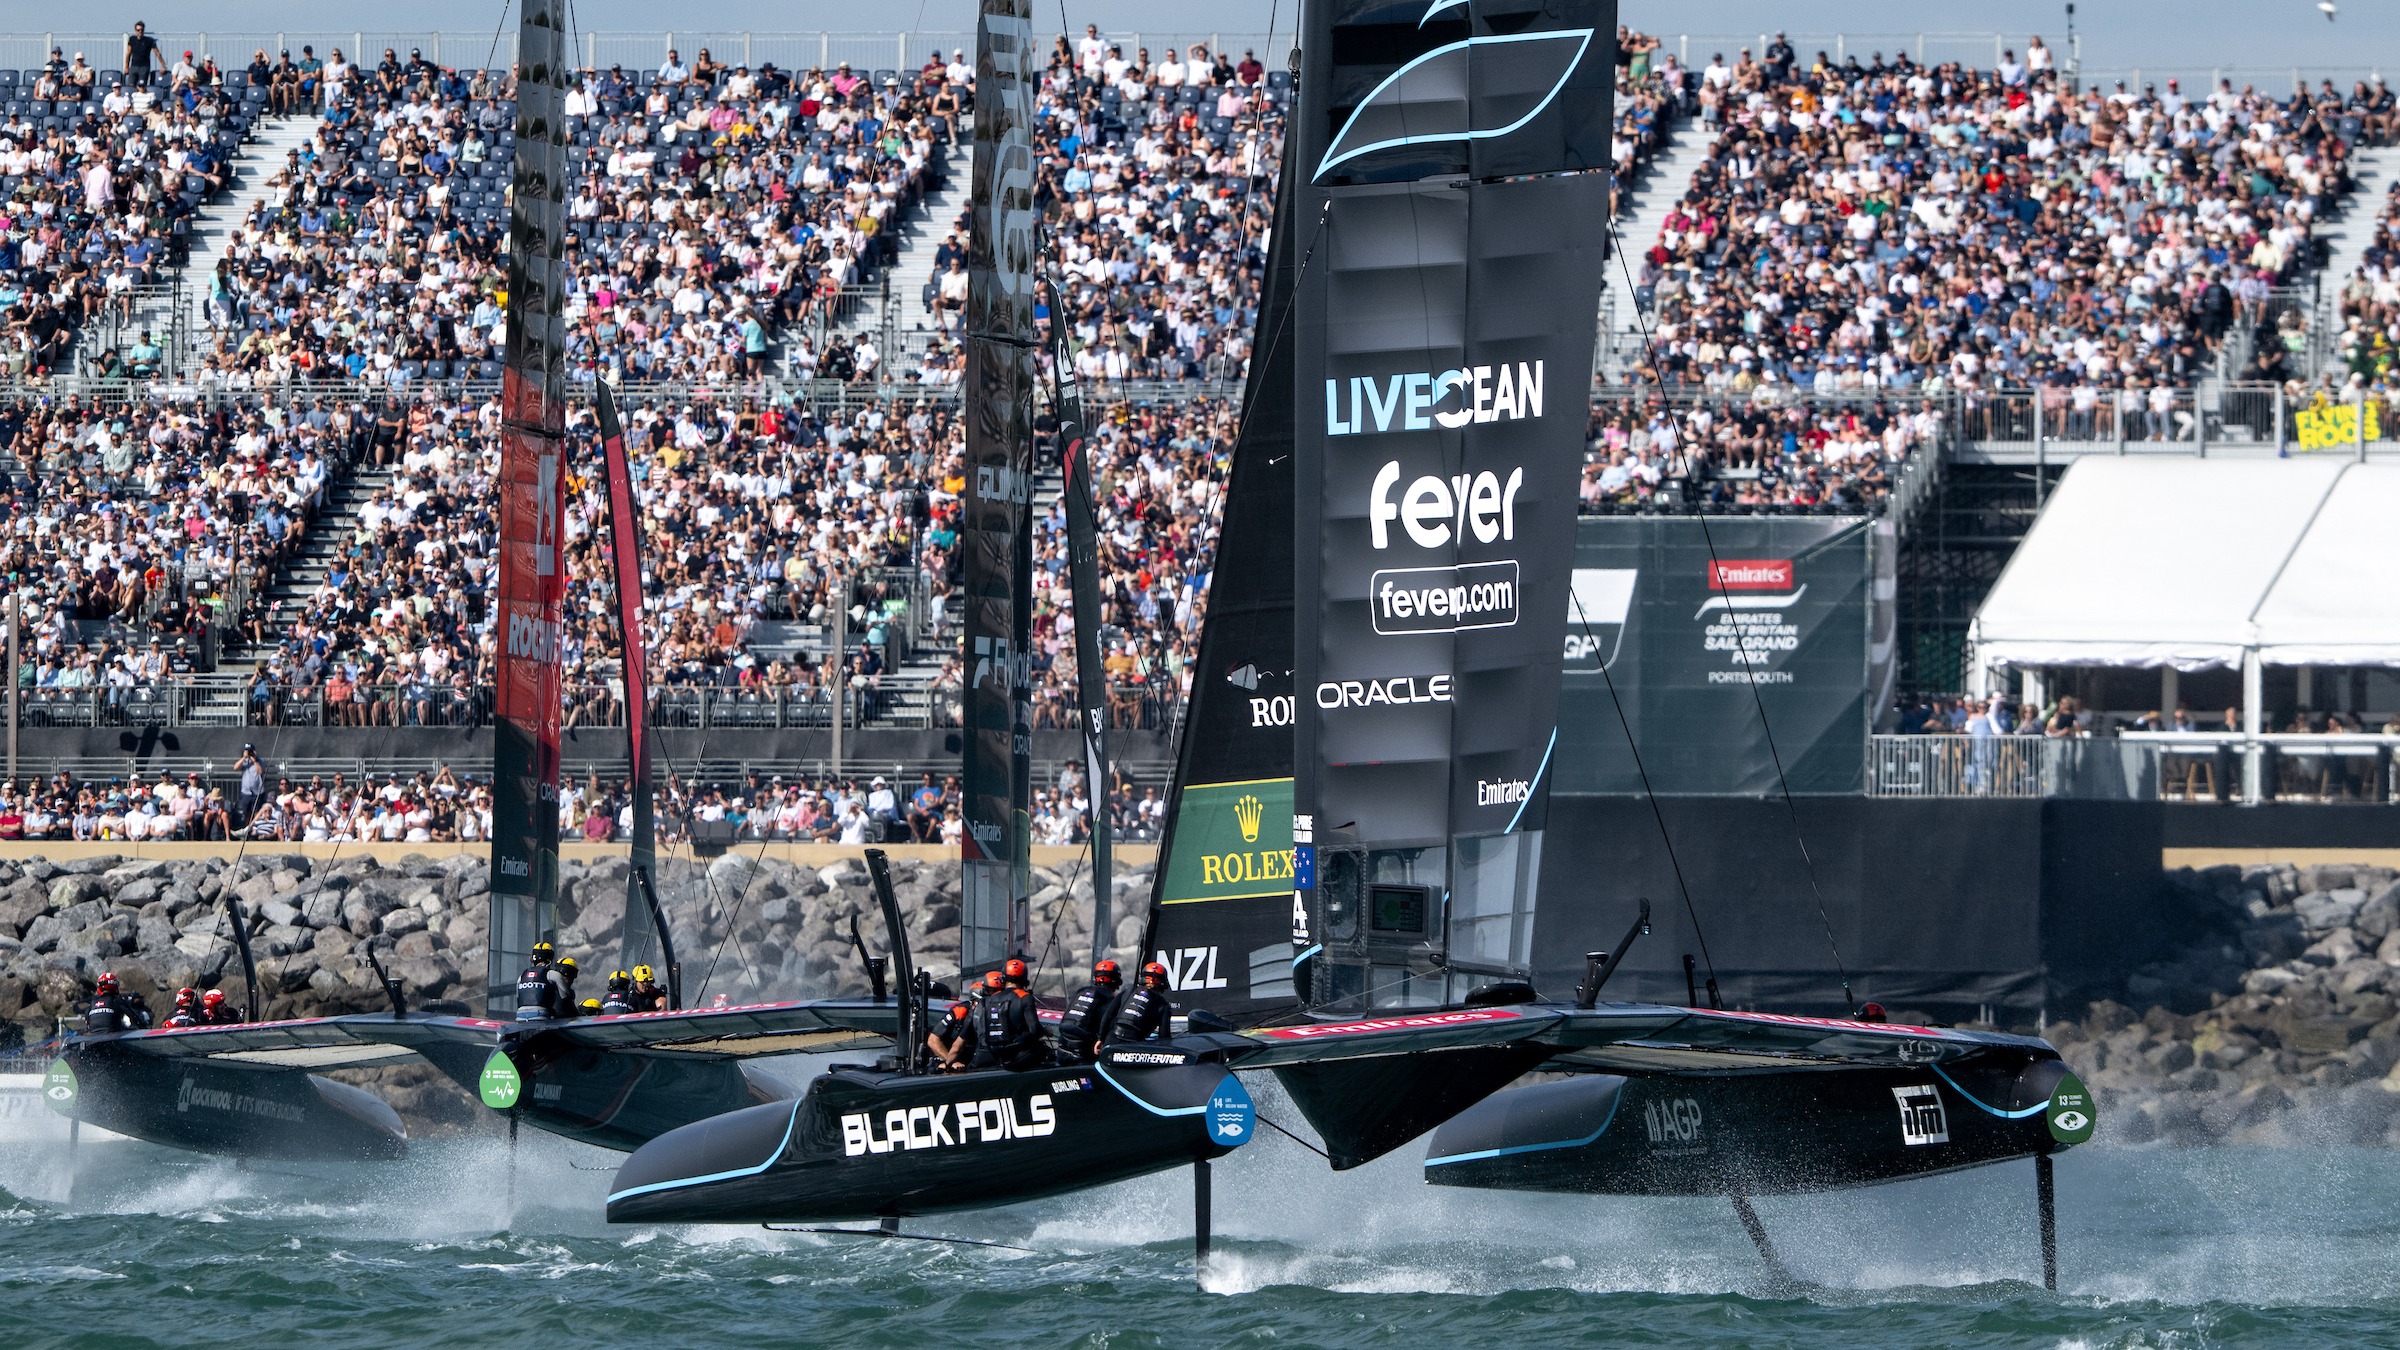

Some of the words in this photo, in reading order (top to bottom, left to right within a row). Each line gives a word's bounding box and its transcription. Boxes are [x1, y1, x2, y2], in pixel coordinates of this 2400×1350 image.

[1717, 566, 1786, 583] Emirates
[1720, 613, 1783, 625] EMIRATES
[1705, 625, 1746, 636] GREAT
[1747, 625, 1798, 636] BRITAIN
[1704, 636, 1740, 650] SAIL
[1741, 636, 1799, 650] GRAND
[1732, 650, 1770, 664] PRIX
[1708, 672, 1793, 684] PORTSMOUTH
[1316, 674, 1455, 709] ORACLE
[1478, 777, 1529, 806] Emirates
[973, 820, 1002, 842] Emirates
[501, 856, 529, 877] Emirates
[1201, 849, 1295, 884] ROLEX
[1156, 946, 1228, 991] NZL
[519, 982, 546, 990] SCOTT
[1288, 1009, 1493, 1036] Emirates
[1113, 1052, 1186, 1065] #RACEFORTHEFUTURE
[485, 1070, 491, 1079] 3
[1051, 1079, 1081, 1093] BURLING
[1213, 1097, 1223, 1108] 14
[2058, 1094, 2068, 1106] 13
[841, 1104, 956, 1157] BLACK
[955, 1094, 1056, 1145] FOILS
